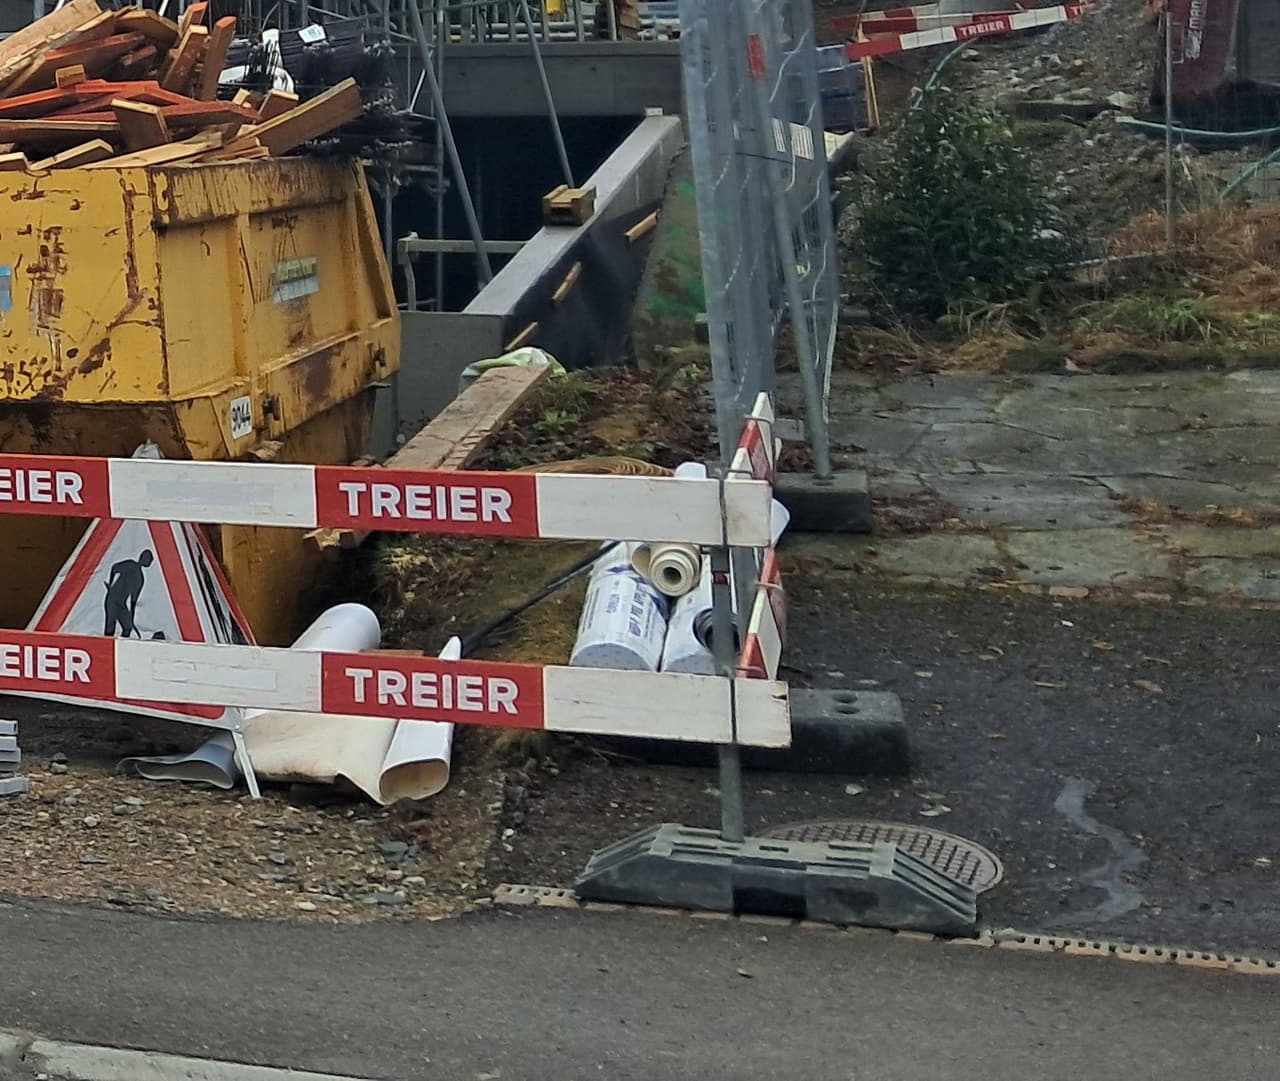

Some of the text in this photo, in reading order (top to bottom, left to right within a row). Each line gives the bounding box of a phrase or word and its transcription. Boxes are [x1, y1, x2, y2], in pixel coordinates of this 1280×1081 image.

[960, 21, 1005, 36] TREIER
[339, 482, 512, 523] TREIER
[345, 667, 519, 715] TREIER
